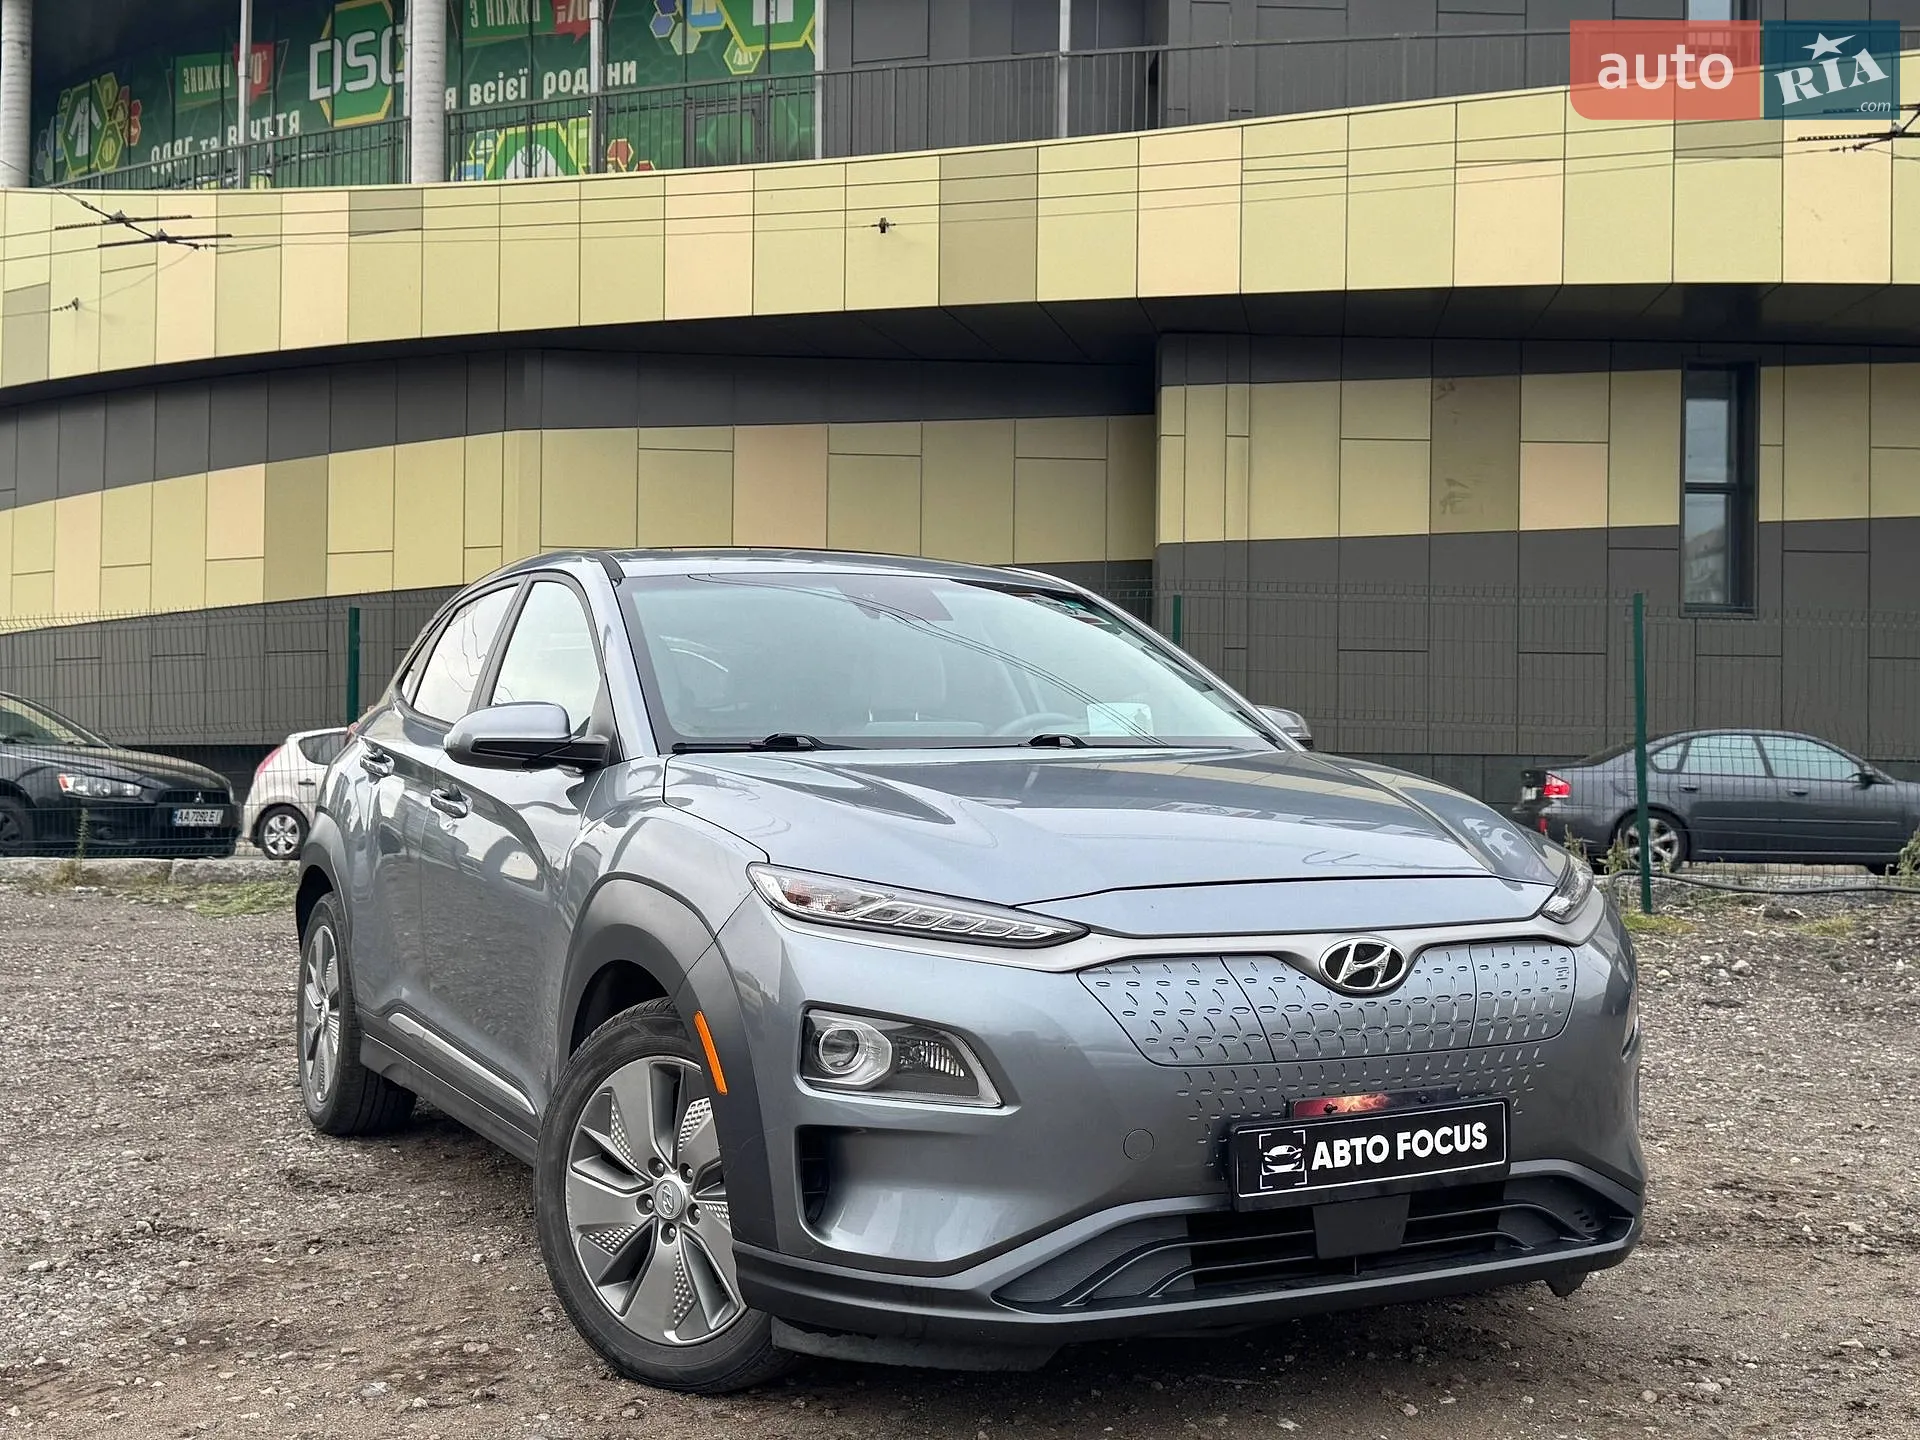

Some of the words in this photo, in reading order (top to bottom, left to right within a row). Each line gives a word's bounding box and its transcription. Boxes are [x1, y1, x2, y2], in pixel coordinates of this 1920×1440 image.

[469, 67, 528, 106] всієї
[543, 60, 636, 99] родни
[1396, 1121, 1488, 1161] FOCUS
